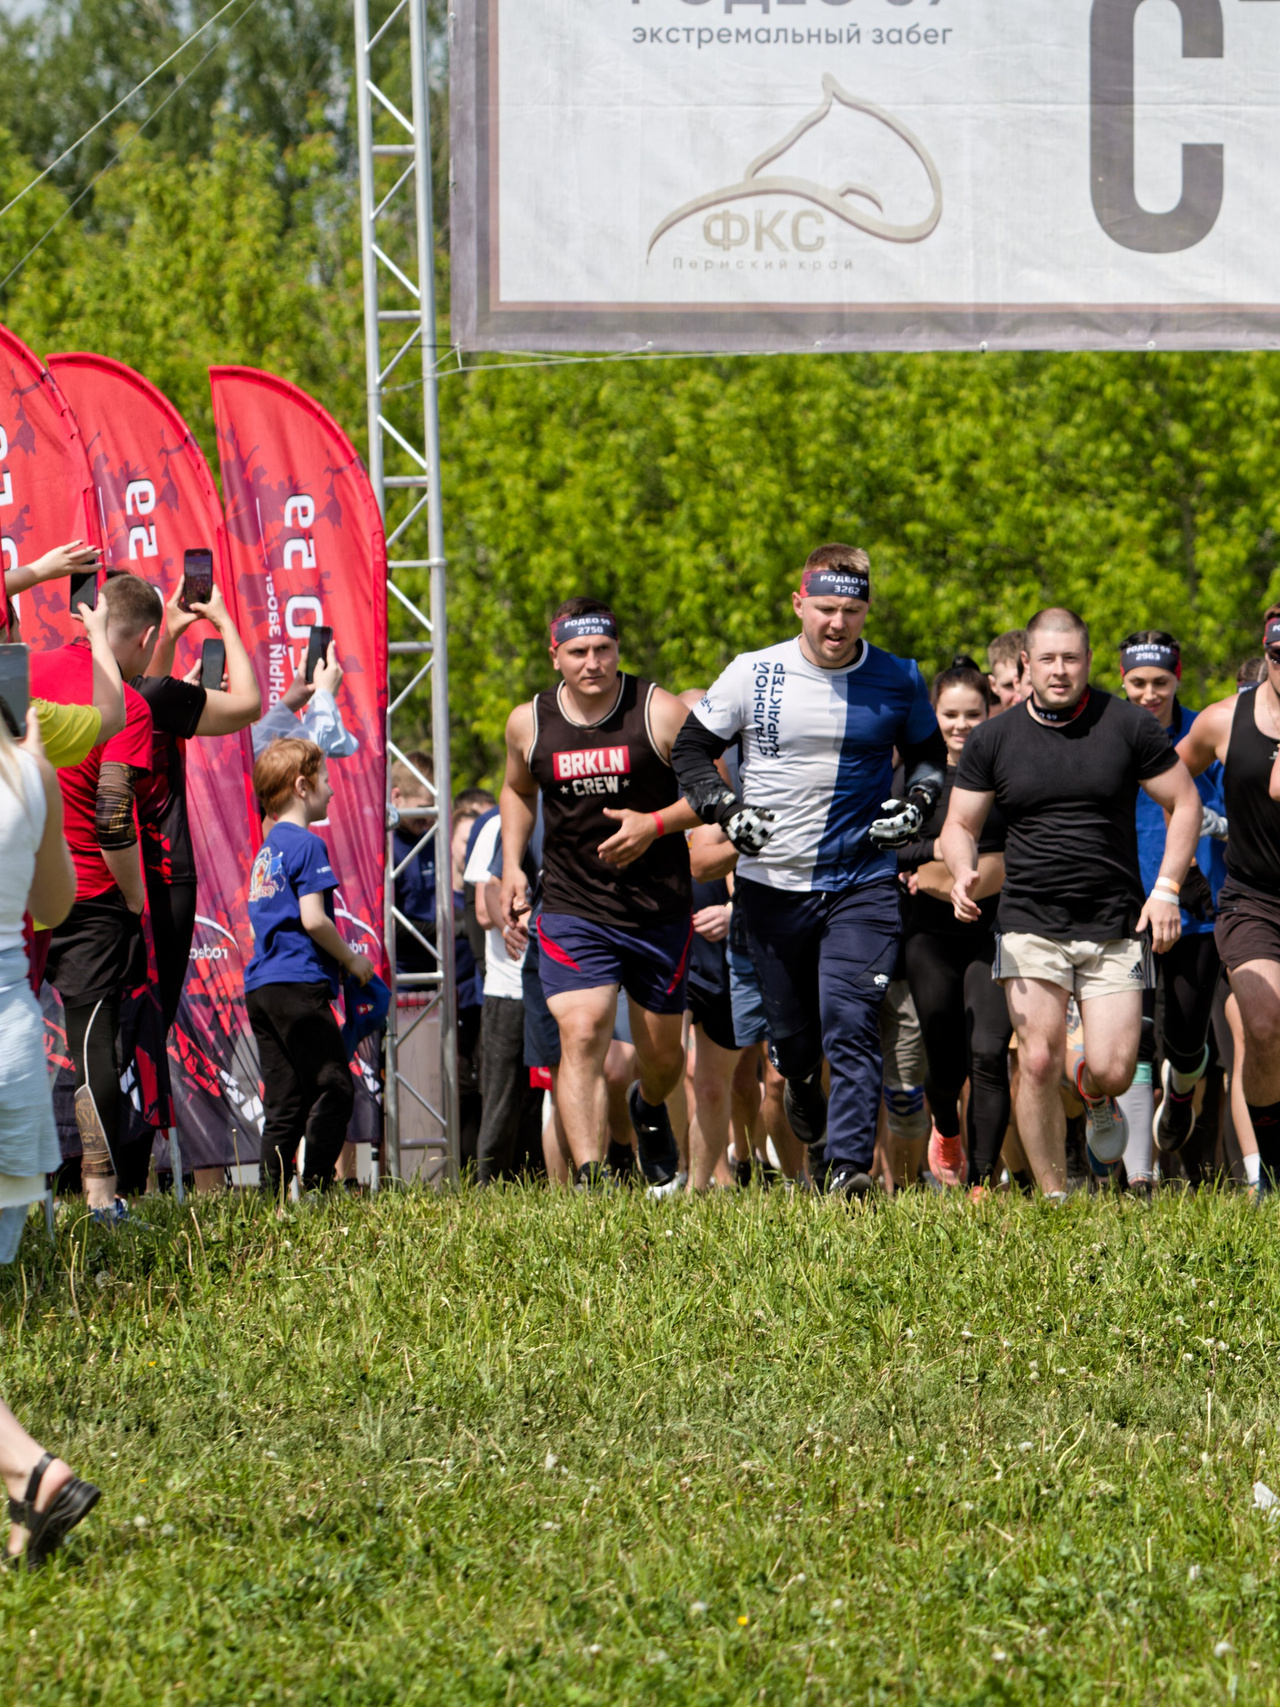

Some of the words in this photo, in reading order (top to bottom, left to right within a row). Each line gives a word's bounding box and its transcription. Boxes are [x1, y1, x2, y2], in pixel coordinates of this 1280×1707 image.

[632, 23, 861, 49] экстремальный
[871, 22, 953, 45] забег
[702, 210, 825, 252] ФКС
[673, 256, 788, 272] Пермский
[798, 257, 853, 272] край
[820, 574, 859, 584] РОДЕО
[834, 585, 860, 595] 3262
[564, 617, 600, 628] РОДЕО
[558, 748, 625, 778] BRKLN
[572, 775, 619, 796] CREW
